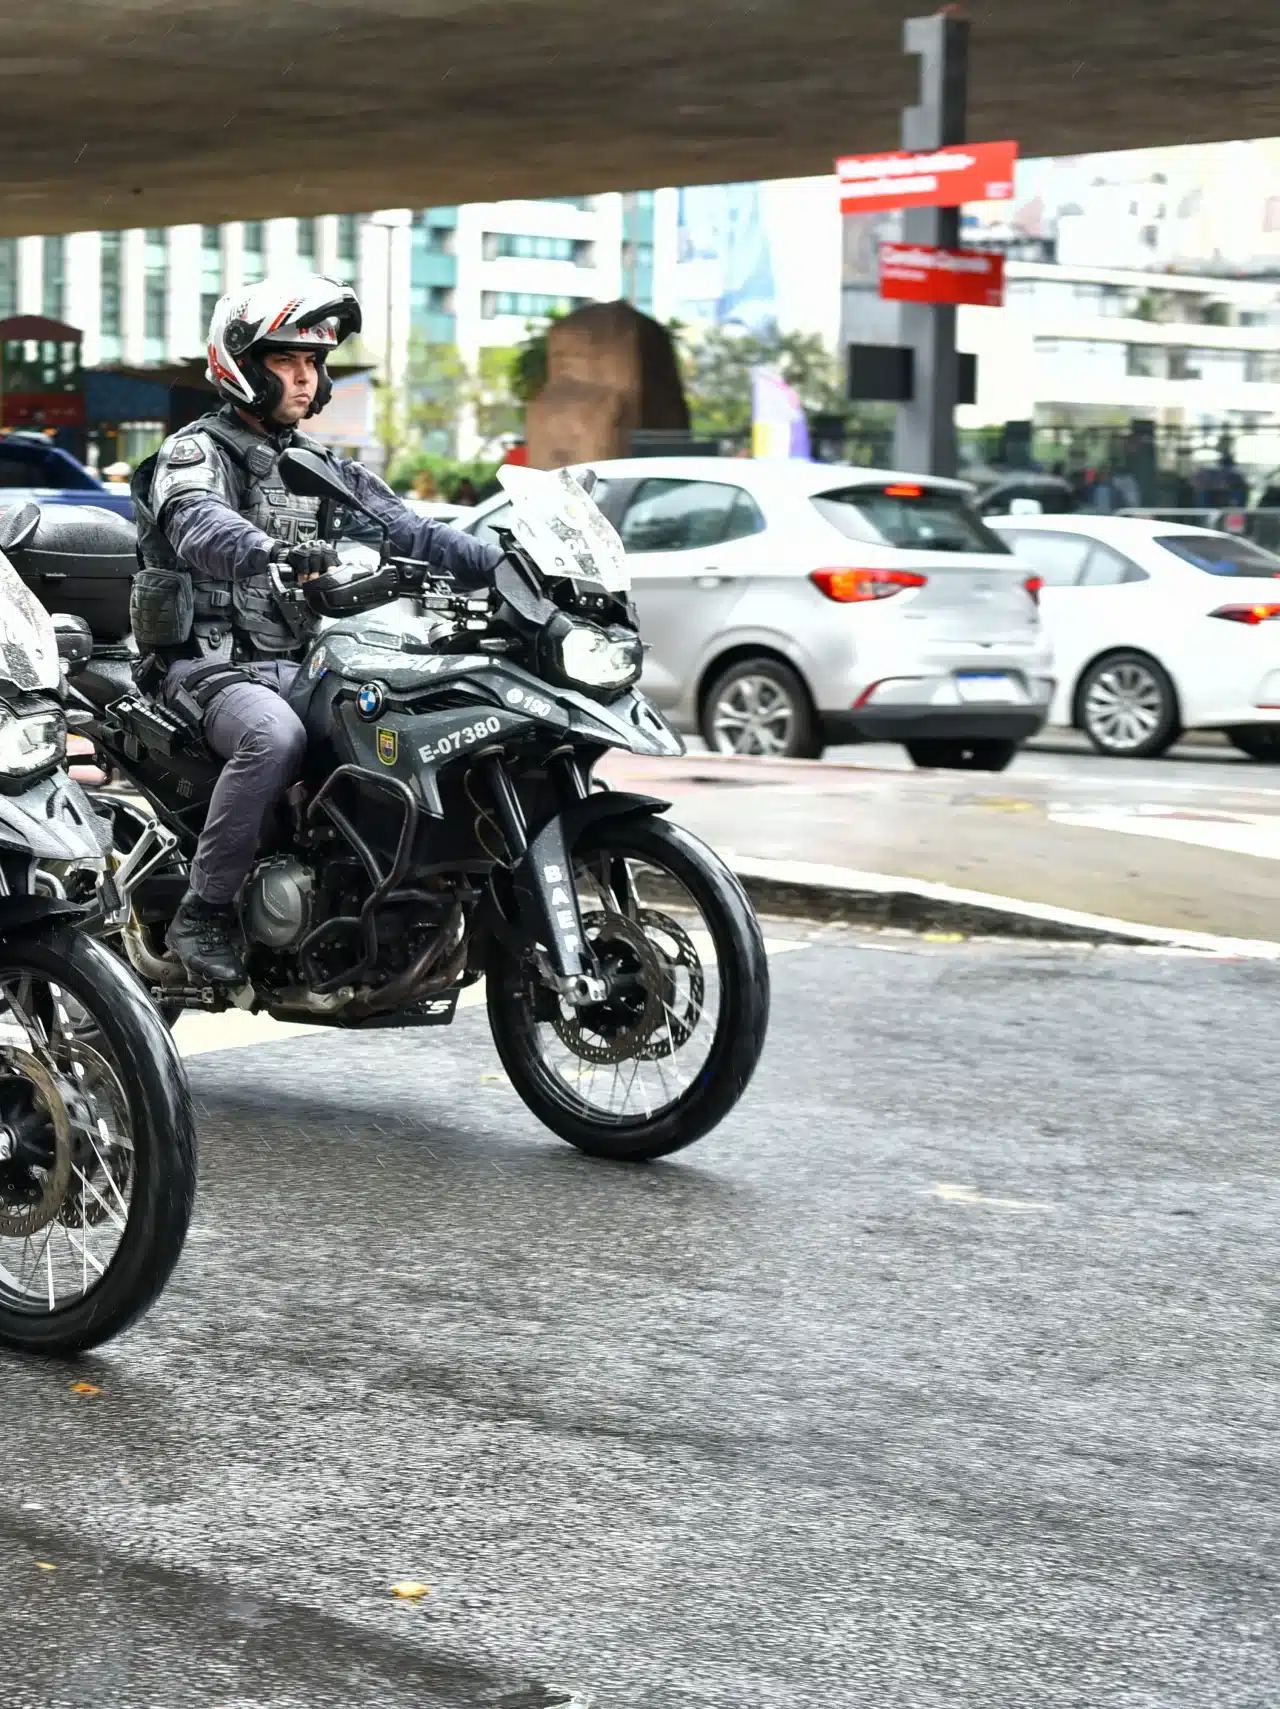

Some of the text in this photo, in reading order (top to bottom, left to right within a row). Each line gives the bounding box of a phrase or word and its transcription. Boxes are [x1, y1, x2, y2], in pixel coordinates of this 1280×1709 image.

[522, 694, 552, 718] 190
[417, 715, 502, 764] E-07380
[543, 864, 579, 953] BAEP
